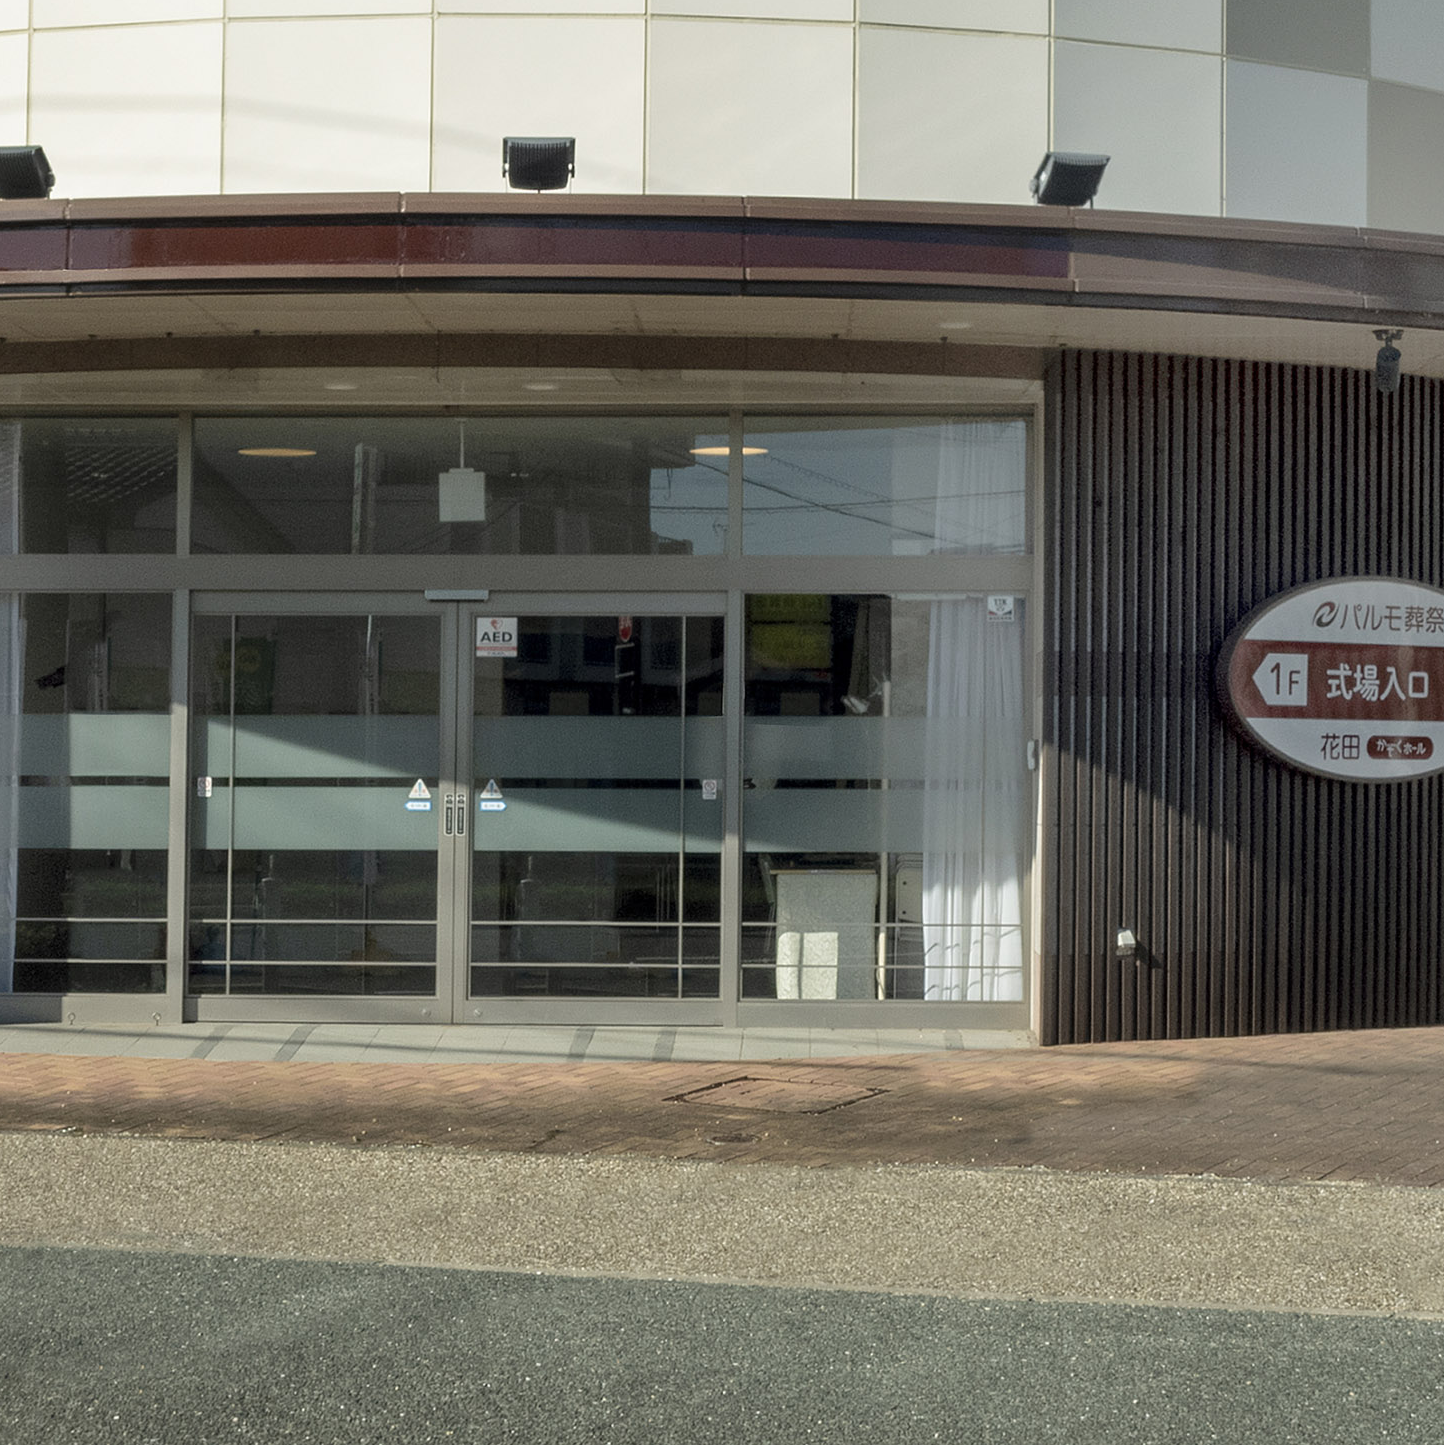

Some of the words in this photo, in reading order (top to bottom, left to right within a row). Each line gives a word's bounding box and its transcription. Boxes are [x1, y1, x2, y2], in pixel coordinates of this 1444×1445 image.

[480, 631, 513, 643] AED
[1269, 661, 1301, 697] 1F
[1325, 662, 1430, 702] 式場入口
[1320, 732, 1361, 761] 花田
